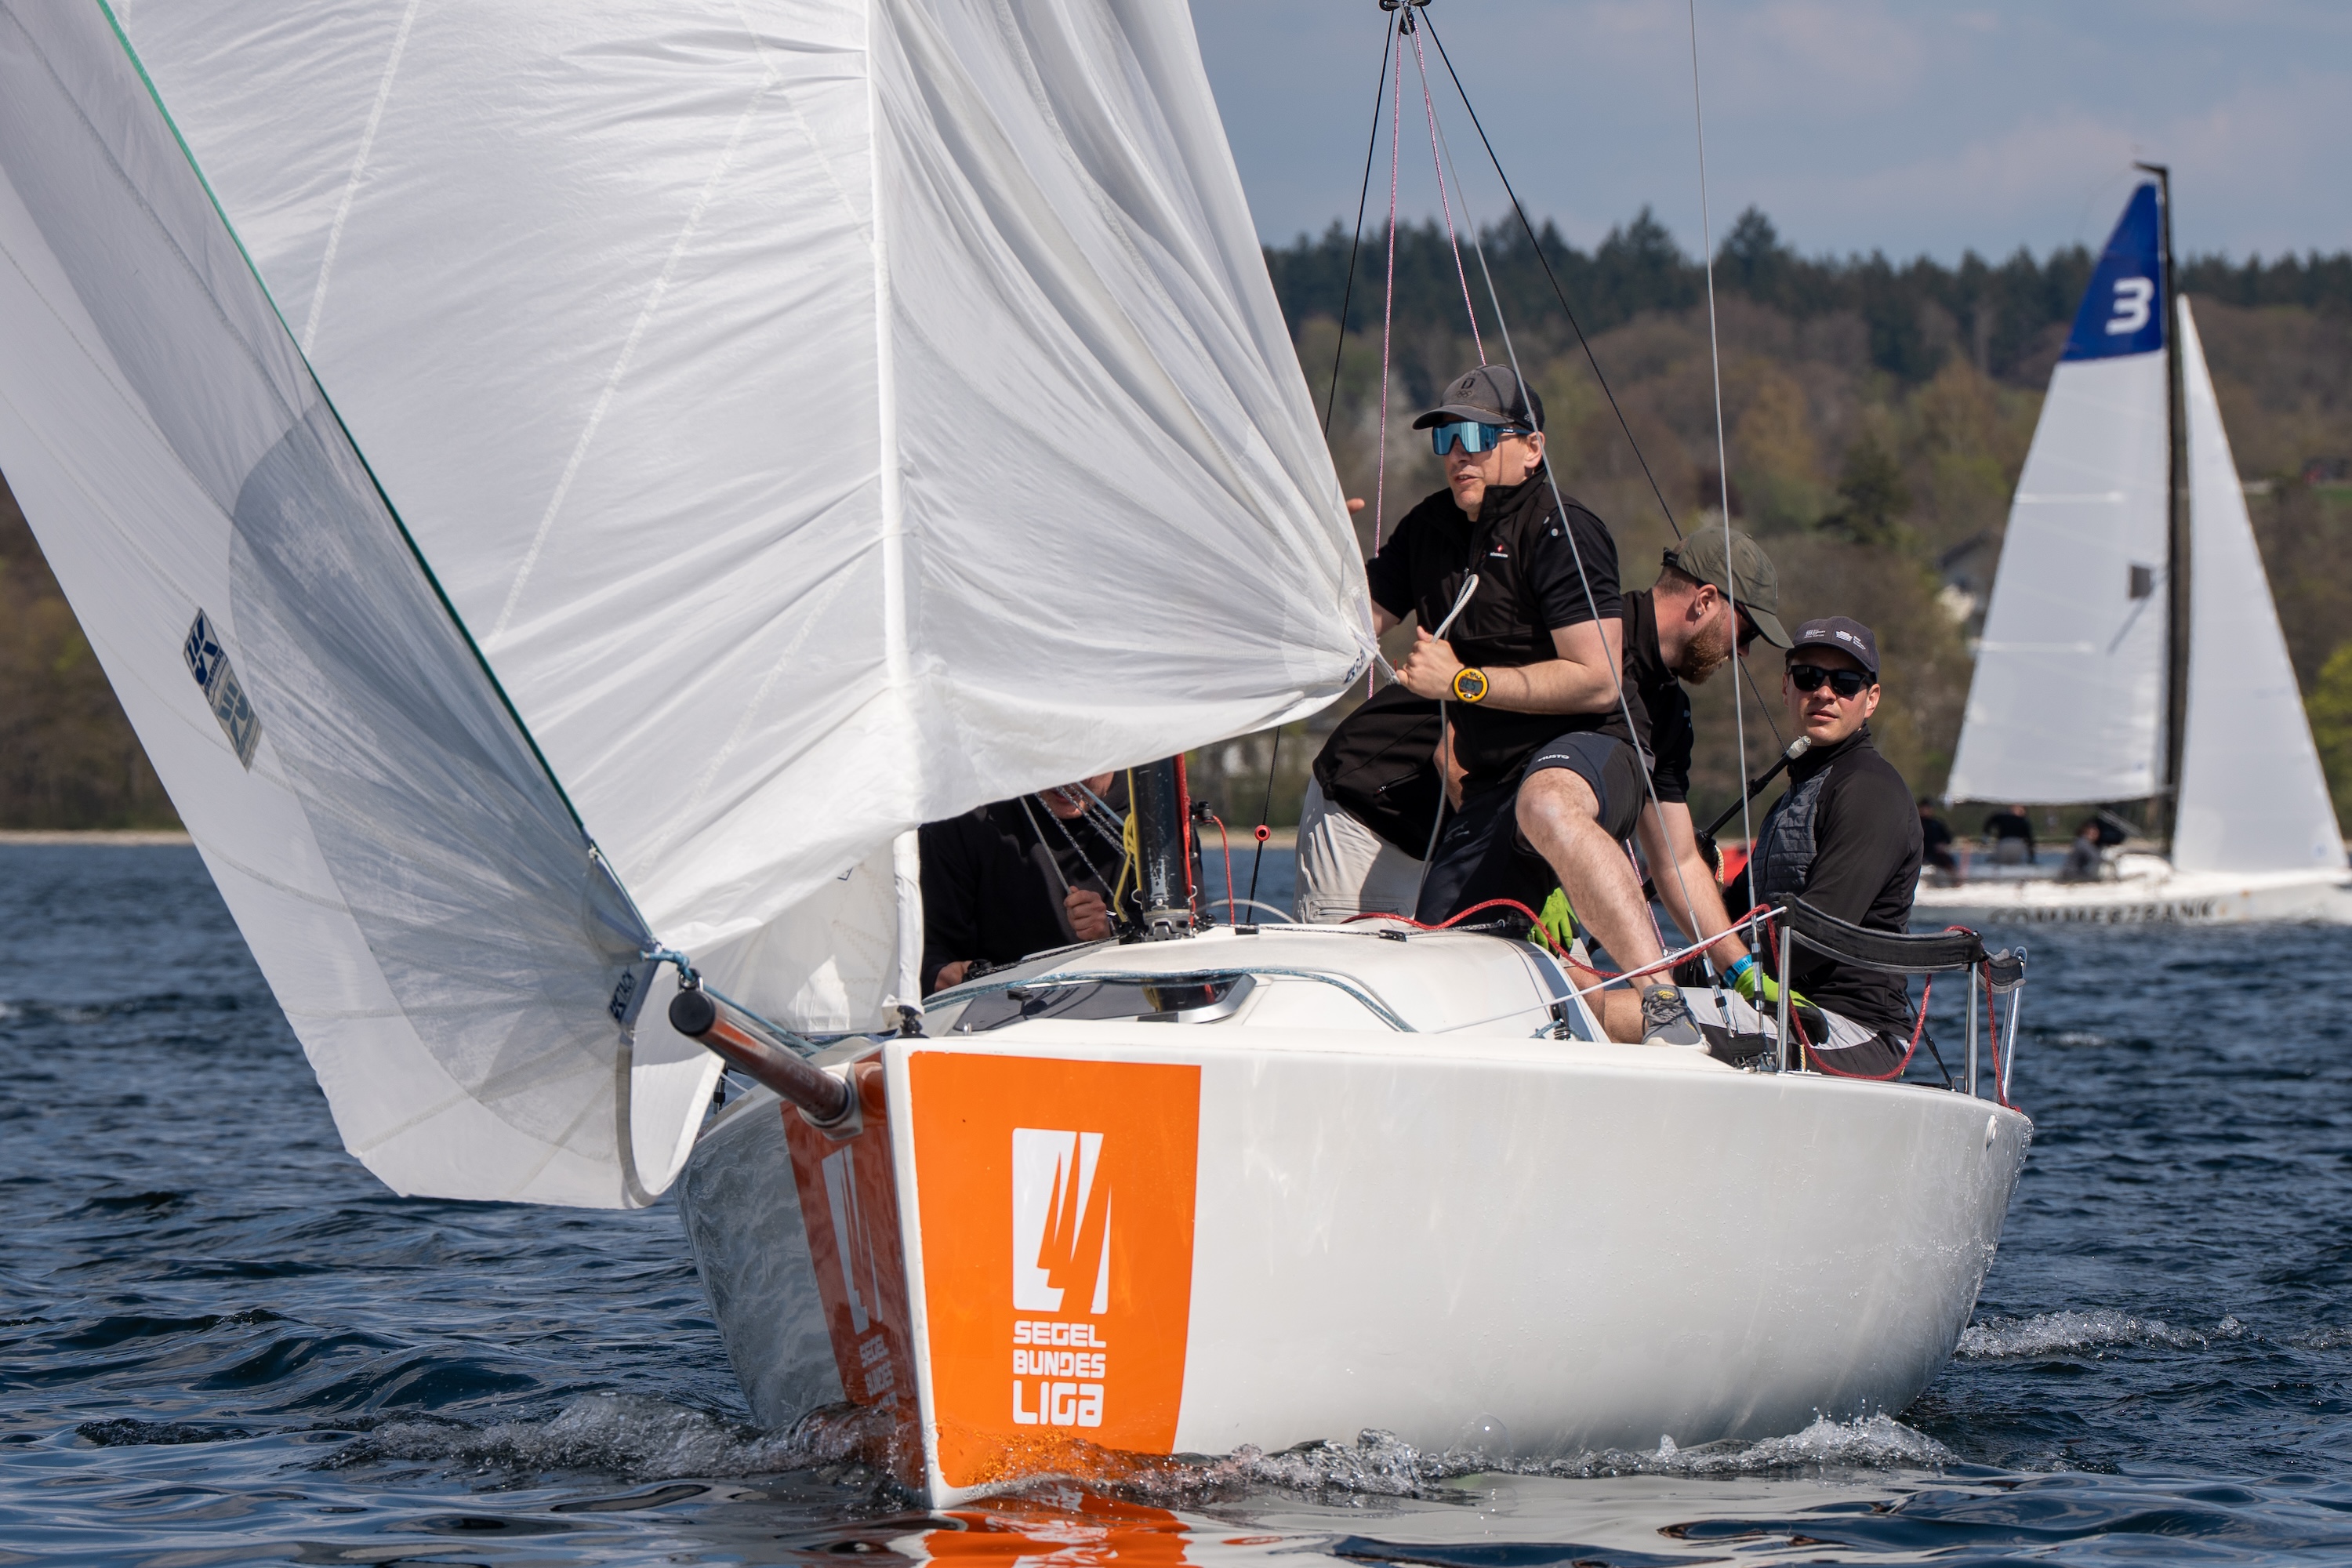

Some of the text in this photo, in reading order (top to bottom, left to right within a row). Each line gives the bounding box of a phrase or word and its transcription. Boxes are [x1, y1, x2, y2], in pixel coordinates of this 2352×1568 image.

[2105, 276, 2155, 336] 3
[1013, 1320, 1107, 1348] SEGEL
[1013, 1349, 1106, 1379] BUNDES
